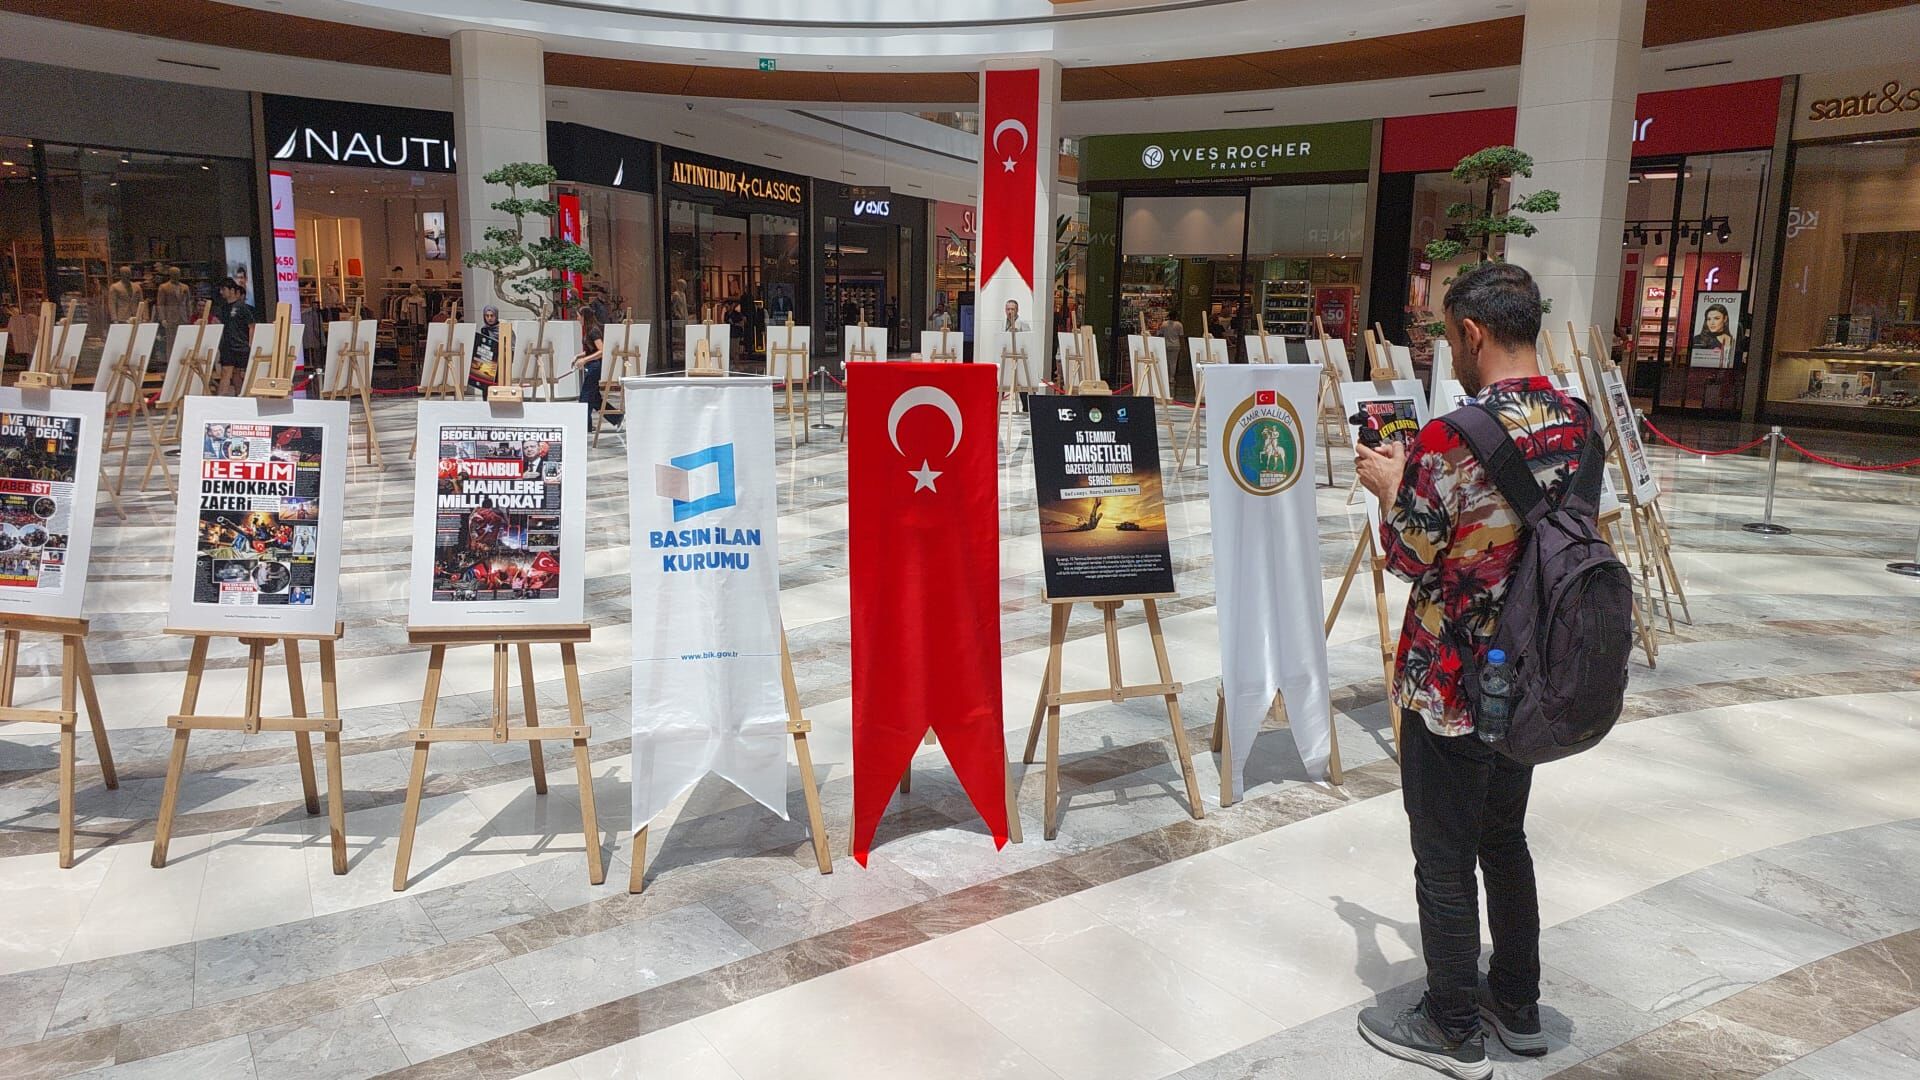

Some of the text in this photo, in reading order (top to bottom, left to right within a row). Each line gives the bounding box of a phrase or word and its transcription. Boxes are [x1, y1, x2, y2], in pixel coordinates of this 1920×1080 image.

[305, 128, 456, 168] NAUTI
[1169, 142, 1312, 162] YVES ROCHER
[1210, 160, 1267, 170] FRANCE
[672, 161, 801, 203] ALTINYILDIZ CLASSICS
[1704, 295, 1736, 304] flormar
[8, 415, 24, 426] VE
[1, 426, 26, 437] DUR
[1075, 431, 1117, 443] 15 TEMMUZ
[202, 480, 294, 497] DEMOKRASİ
[200, 495, 251, 511] ZAFERİ
[488, 494, 545, 509] TOKAT
[649, 527, 761, 549] BASIN İLAN
[663, 552, 750, 572] KURUMU
[681, 650, 739, 661] www.bik.gov.tr
